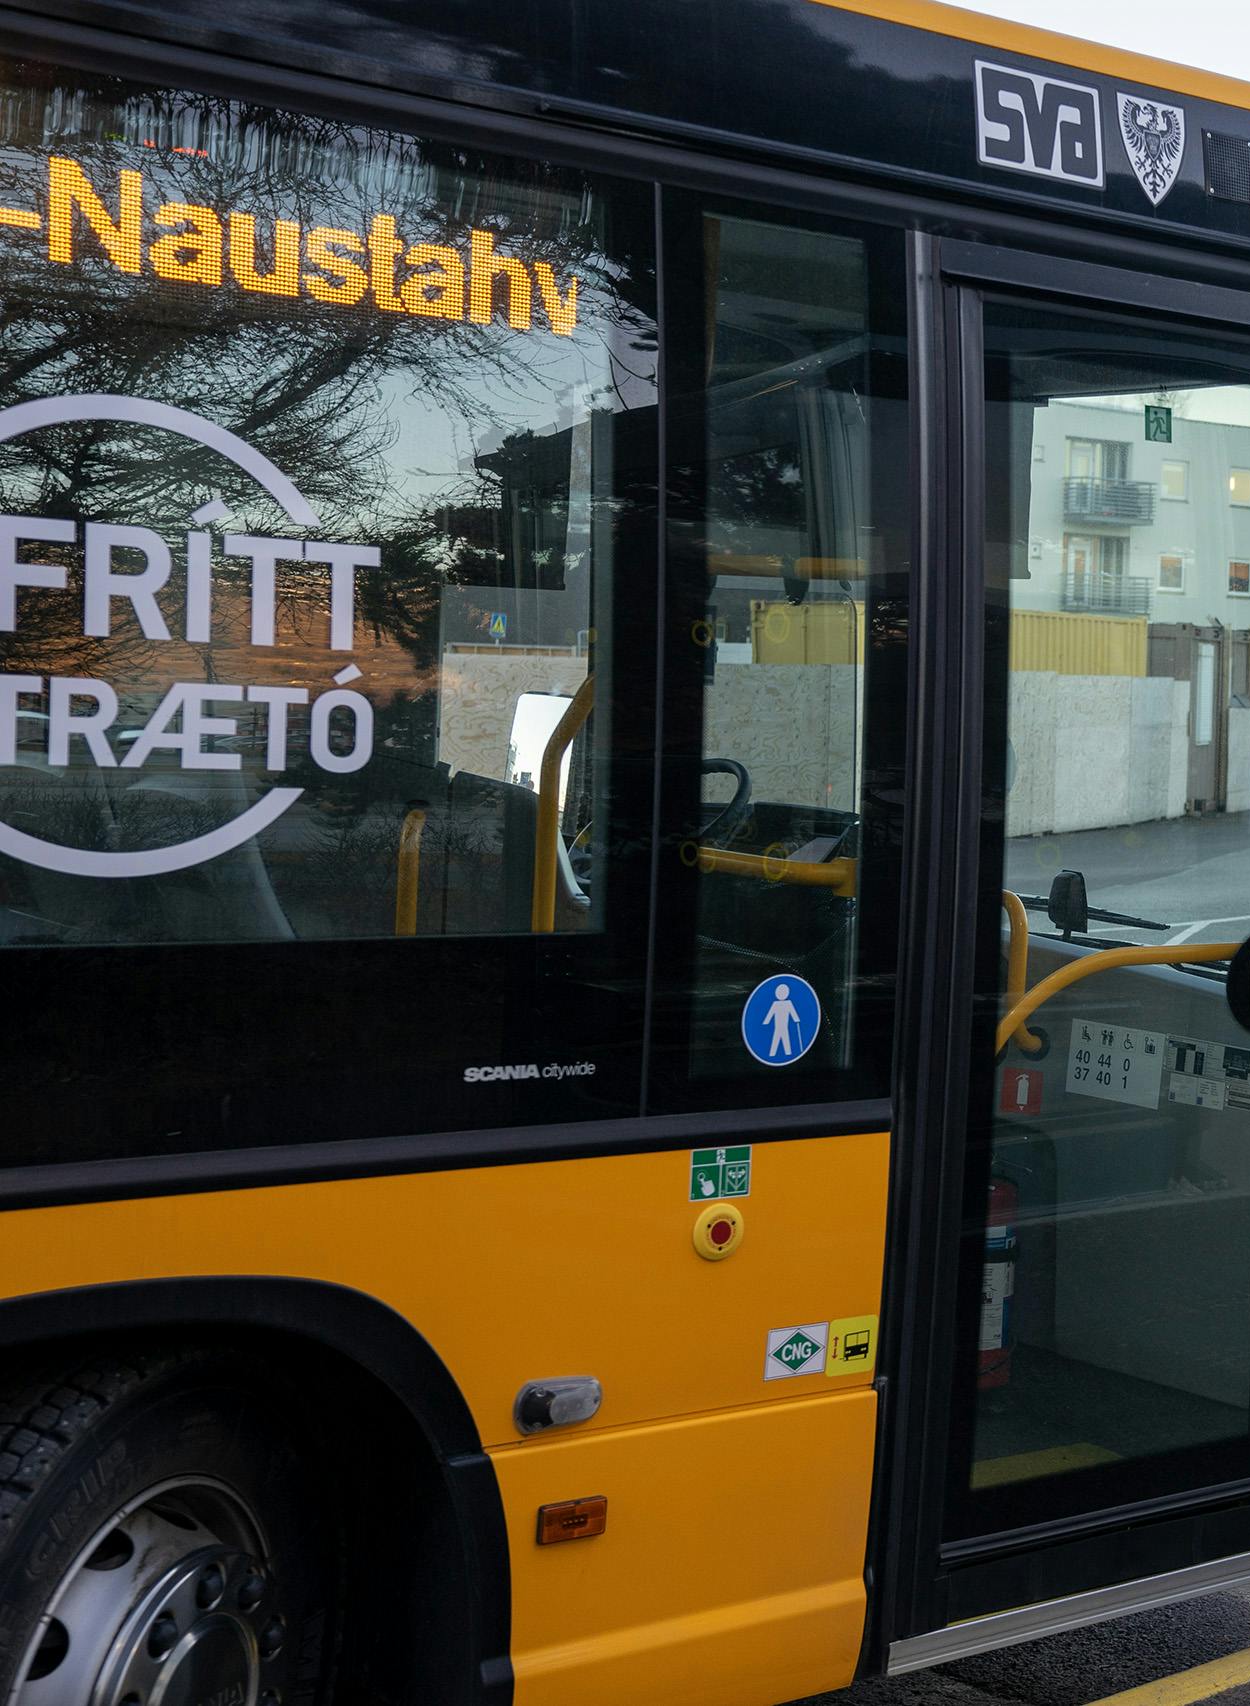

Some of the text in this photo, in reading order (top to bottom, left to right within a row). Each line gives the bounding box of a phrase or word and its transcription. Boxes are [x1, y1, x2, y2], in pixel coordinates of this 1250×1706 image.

[0, 499, 382, 652] FRÍTT
[463, 1061, 597, 1083] SCANIA citywide
[1075, 1049, 1131, 1072] 40 44 0
[1074, 1066, 1128, 1089] 37 40 1
[781, 1341, 812, 1362] CNG
